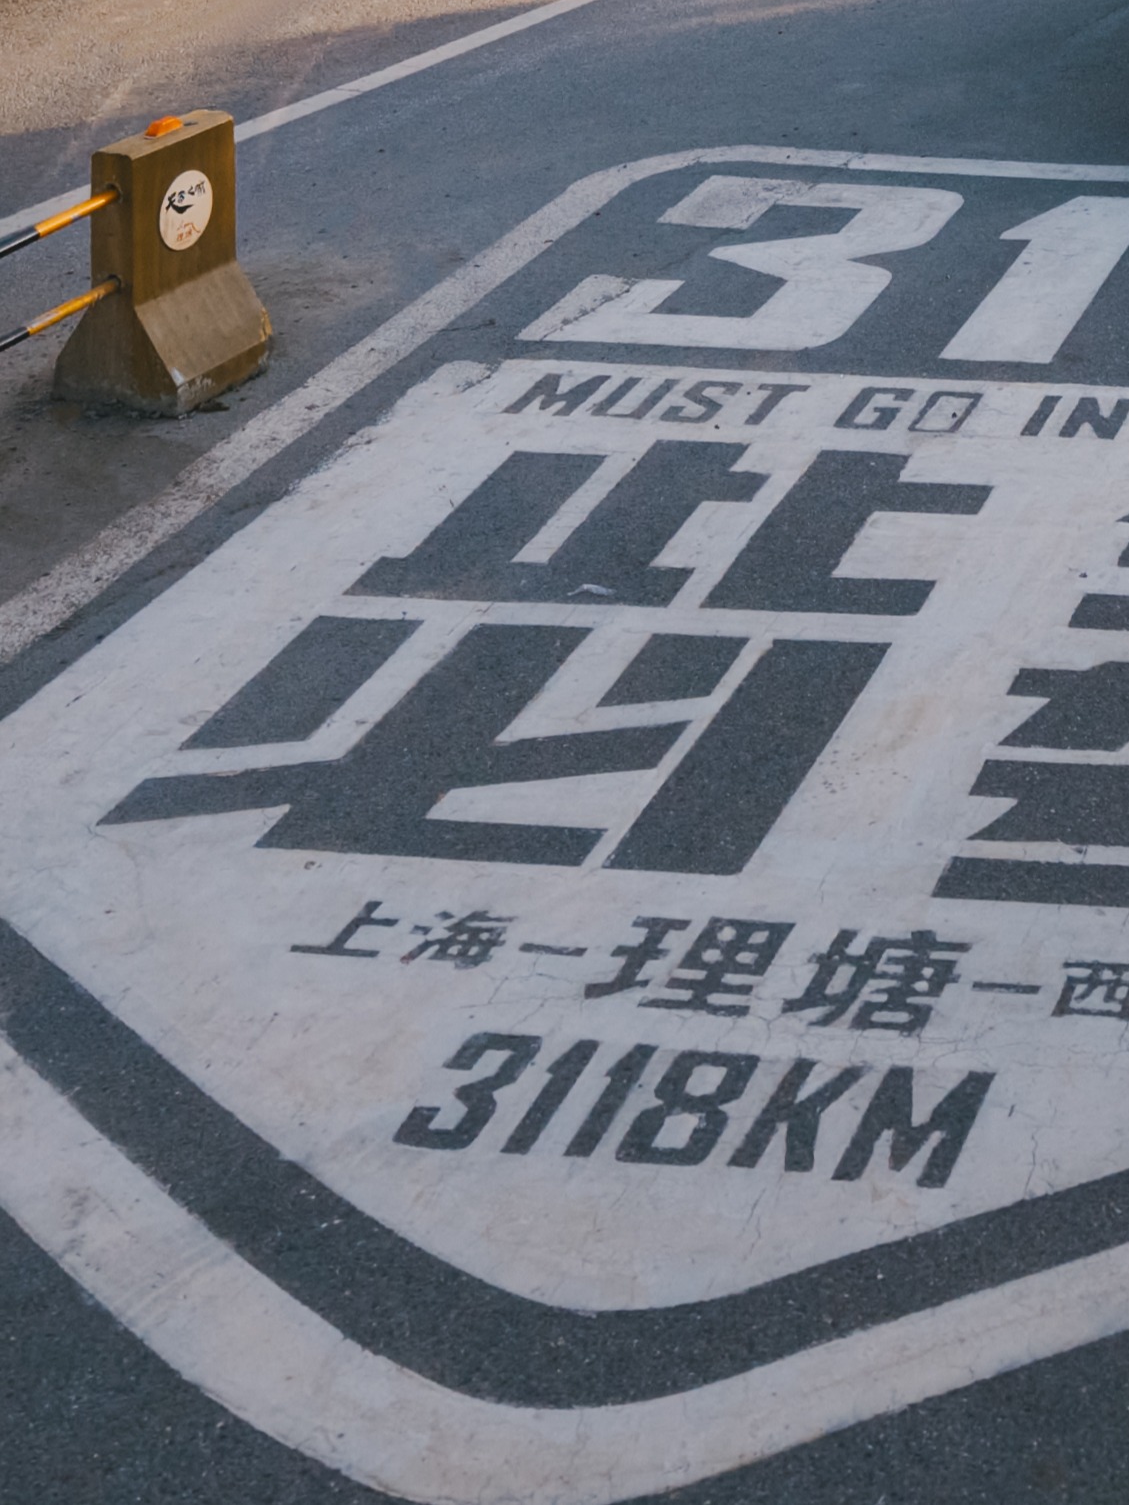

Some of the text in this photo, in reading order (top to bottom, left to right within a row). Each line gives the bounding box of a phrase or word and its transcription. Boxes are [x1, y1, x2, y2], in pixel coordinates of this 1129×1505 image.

[503, 371, 809, 421] MUST
[838, 383, 988, 436] GO
[392, 1031, 996, 1189] 3118KM
